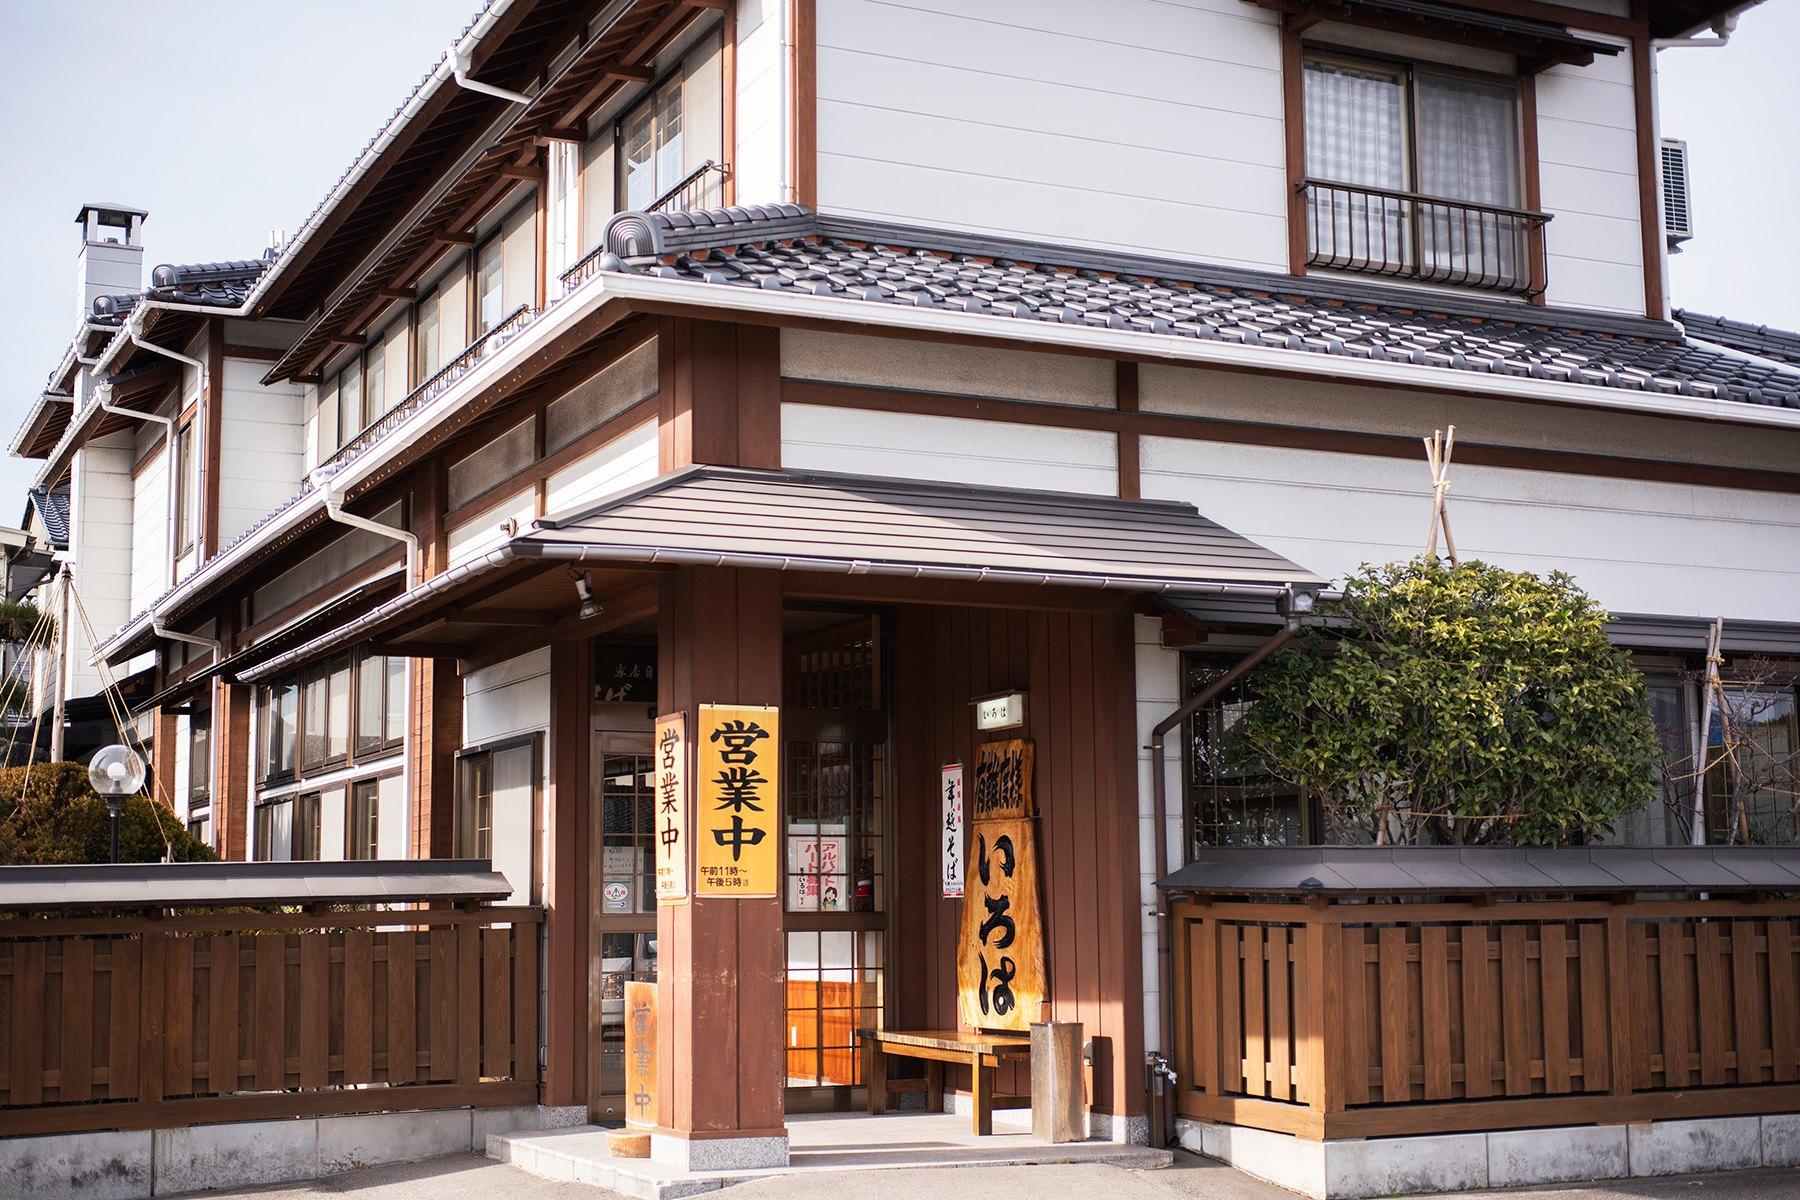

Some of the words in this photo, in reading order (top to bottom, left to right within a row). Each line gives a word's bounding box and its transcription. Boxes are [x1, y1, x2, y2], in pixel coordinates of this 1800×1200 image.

[983, 706, 1007, 720] いろは
[659, 728, 680, 860] 営業中
[710, 719, 769, 862] 営業中
[821, 843, 837, 887] アルバイト
[978, 832, 1016, 1016] いろは
[633, 1002, 652, 1119] 営業中
